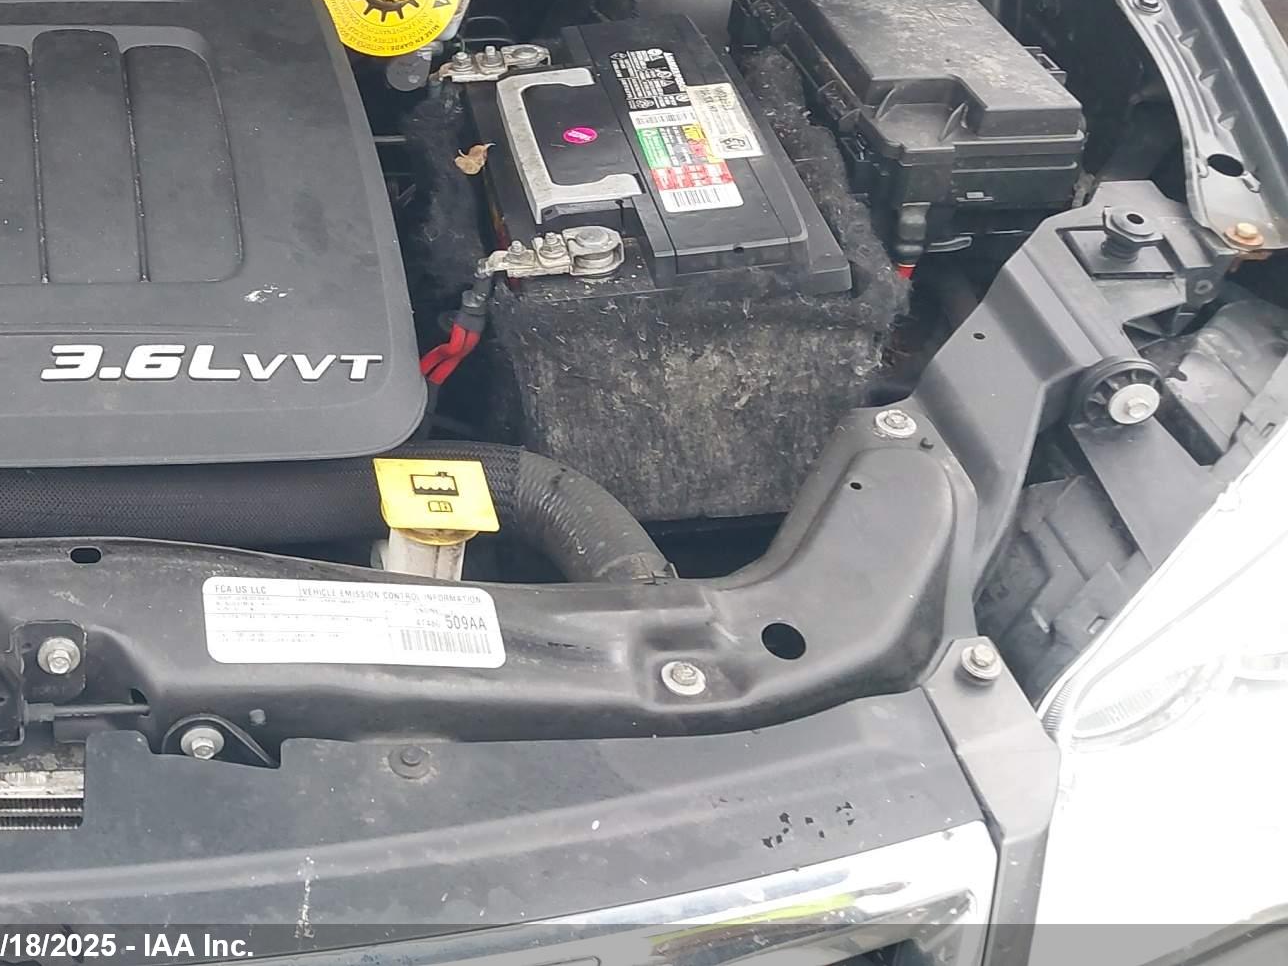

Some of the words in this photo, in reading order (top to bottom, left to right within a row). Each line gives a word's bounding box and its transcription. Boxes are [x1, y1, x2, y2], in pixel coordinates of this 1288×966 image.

[40, 344, 241, 381] 3.6L
[242, 353, 383, 381] VVT
[215, 584, 232, 594] FCA
[235, 585, 248, 594] US
[250, 585, 267, 595] LLC
[301, 587, 337, 598] VEHICLE
[339, 589, 380, 599] EMISSION
[382, 591, 421, 601] CONTROL
[423, 593, 481, 604] INFORMATION
[445, 615, 488, 631] 509AA
